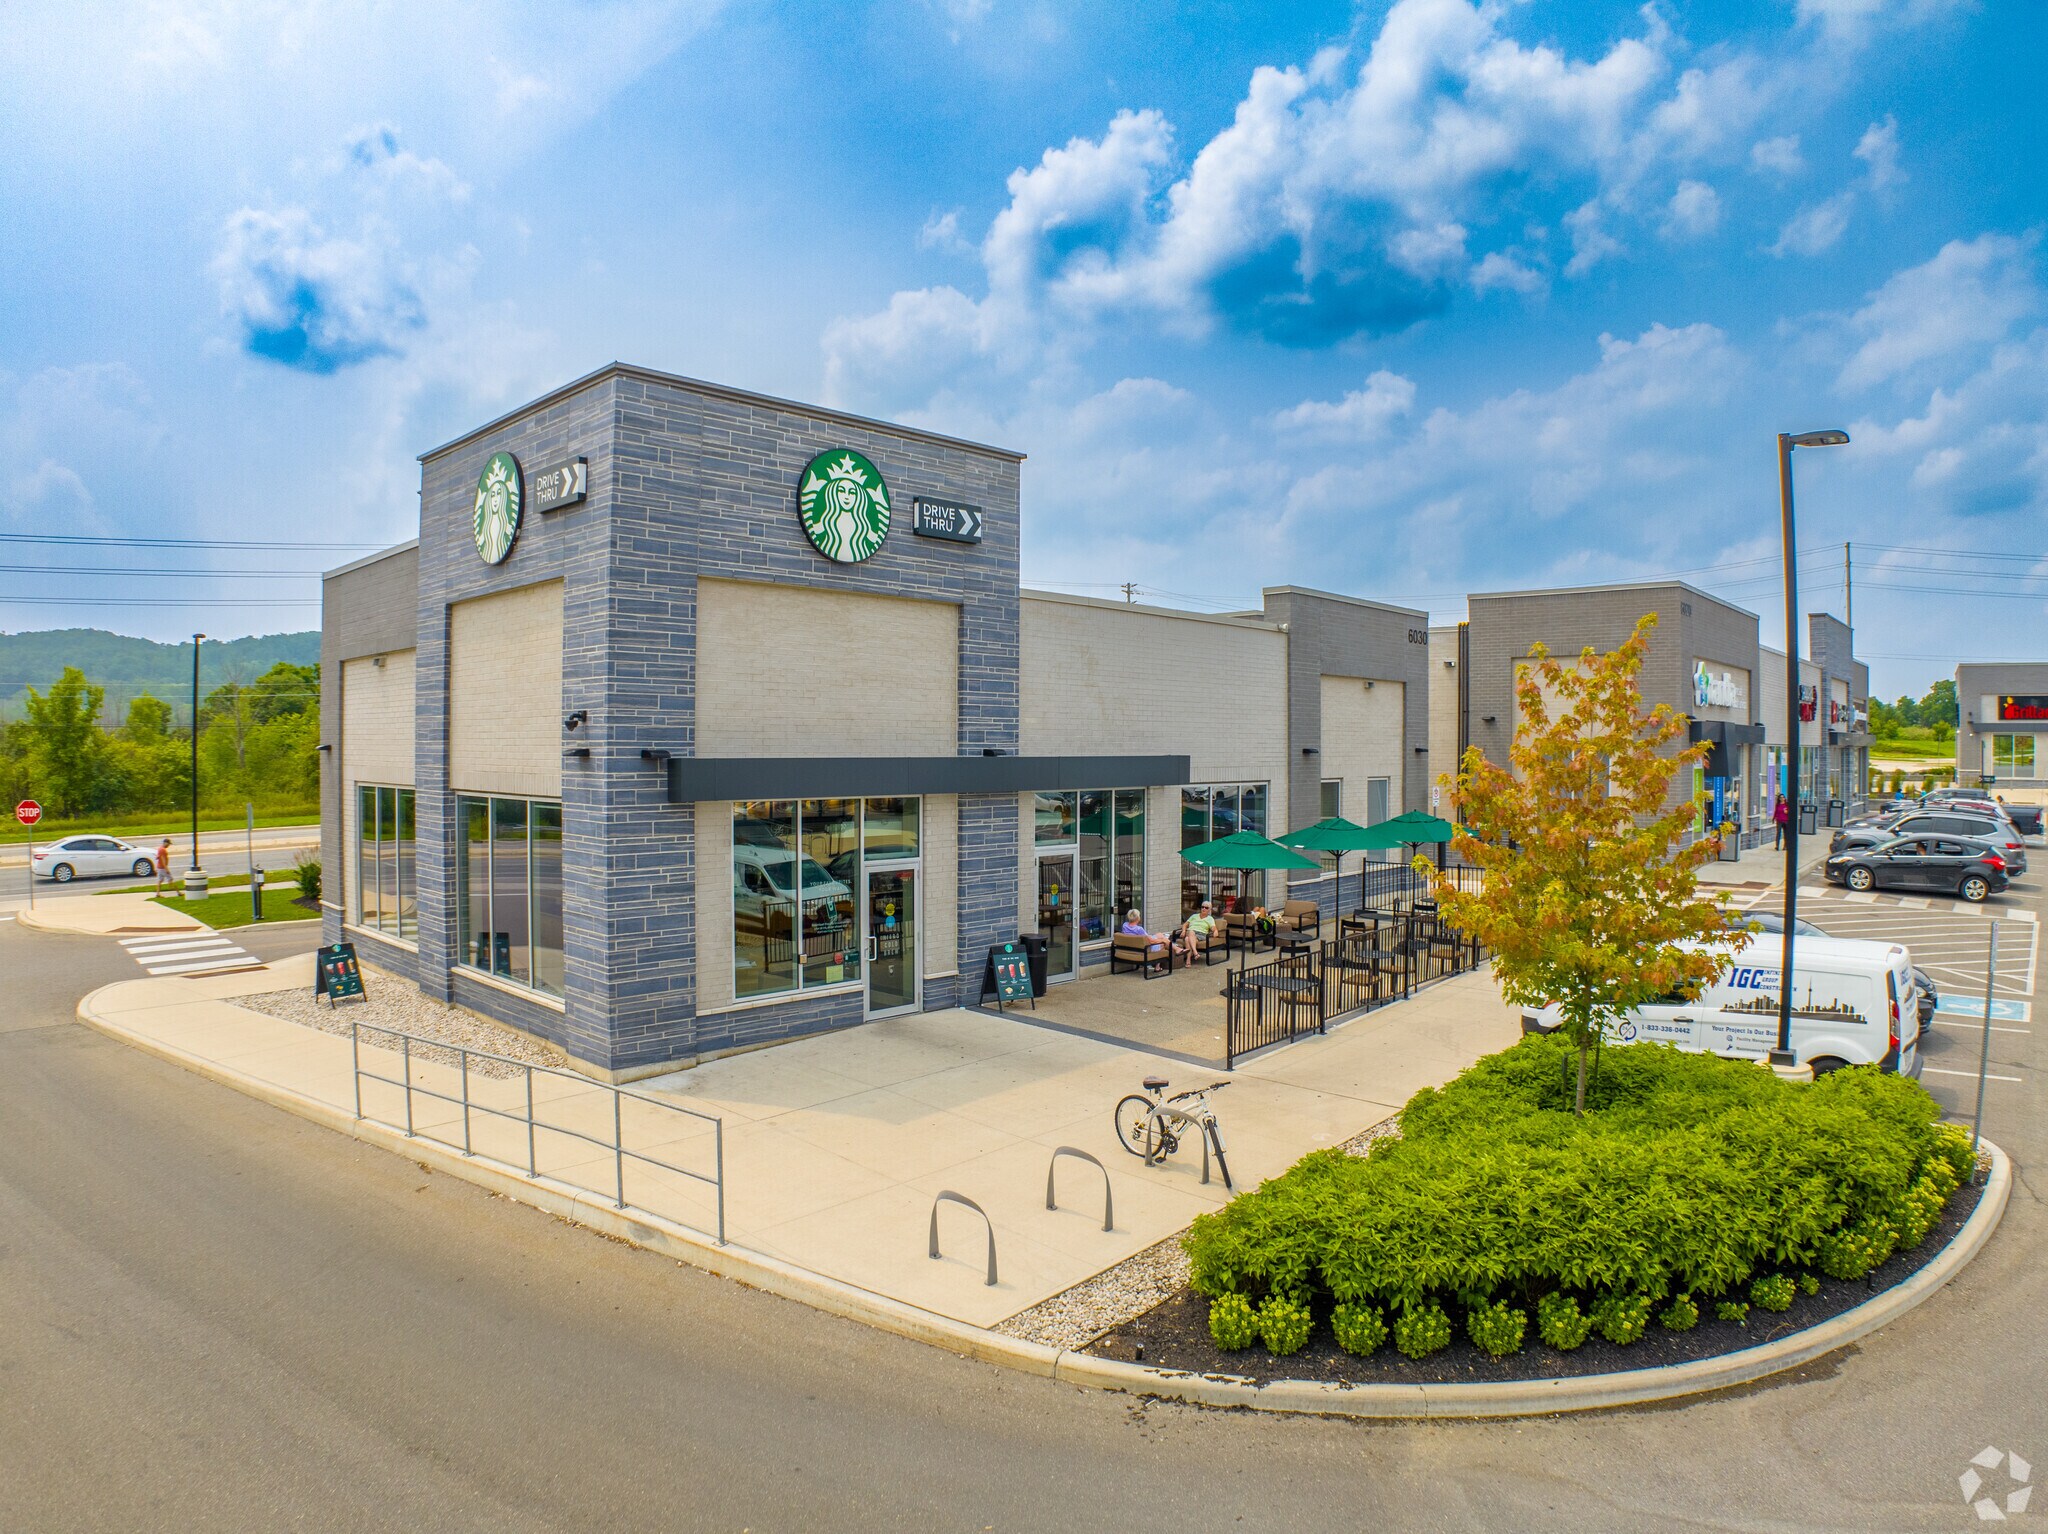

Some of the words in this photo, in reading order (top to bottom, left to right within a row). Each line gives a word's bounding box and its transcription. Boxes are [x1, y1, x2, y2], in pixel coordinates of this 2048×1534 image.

[536, 471, 560, 491] DRIVE
[536, 486, 558, 505] THRU
[923, 503, 956, 520] DRIVE
[923, 516, 953, 533] THRU
[1408, 628, 1428, 645] 6030
[19, 807, 41, 818] STOP
[1728, 968, 1764, 989] IGC
[1641, 1024, 1691, 1034] 1-833-336-0442
[1726, 1026, 1746, 1034] Project
